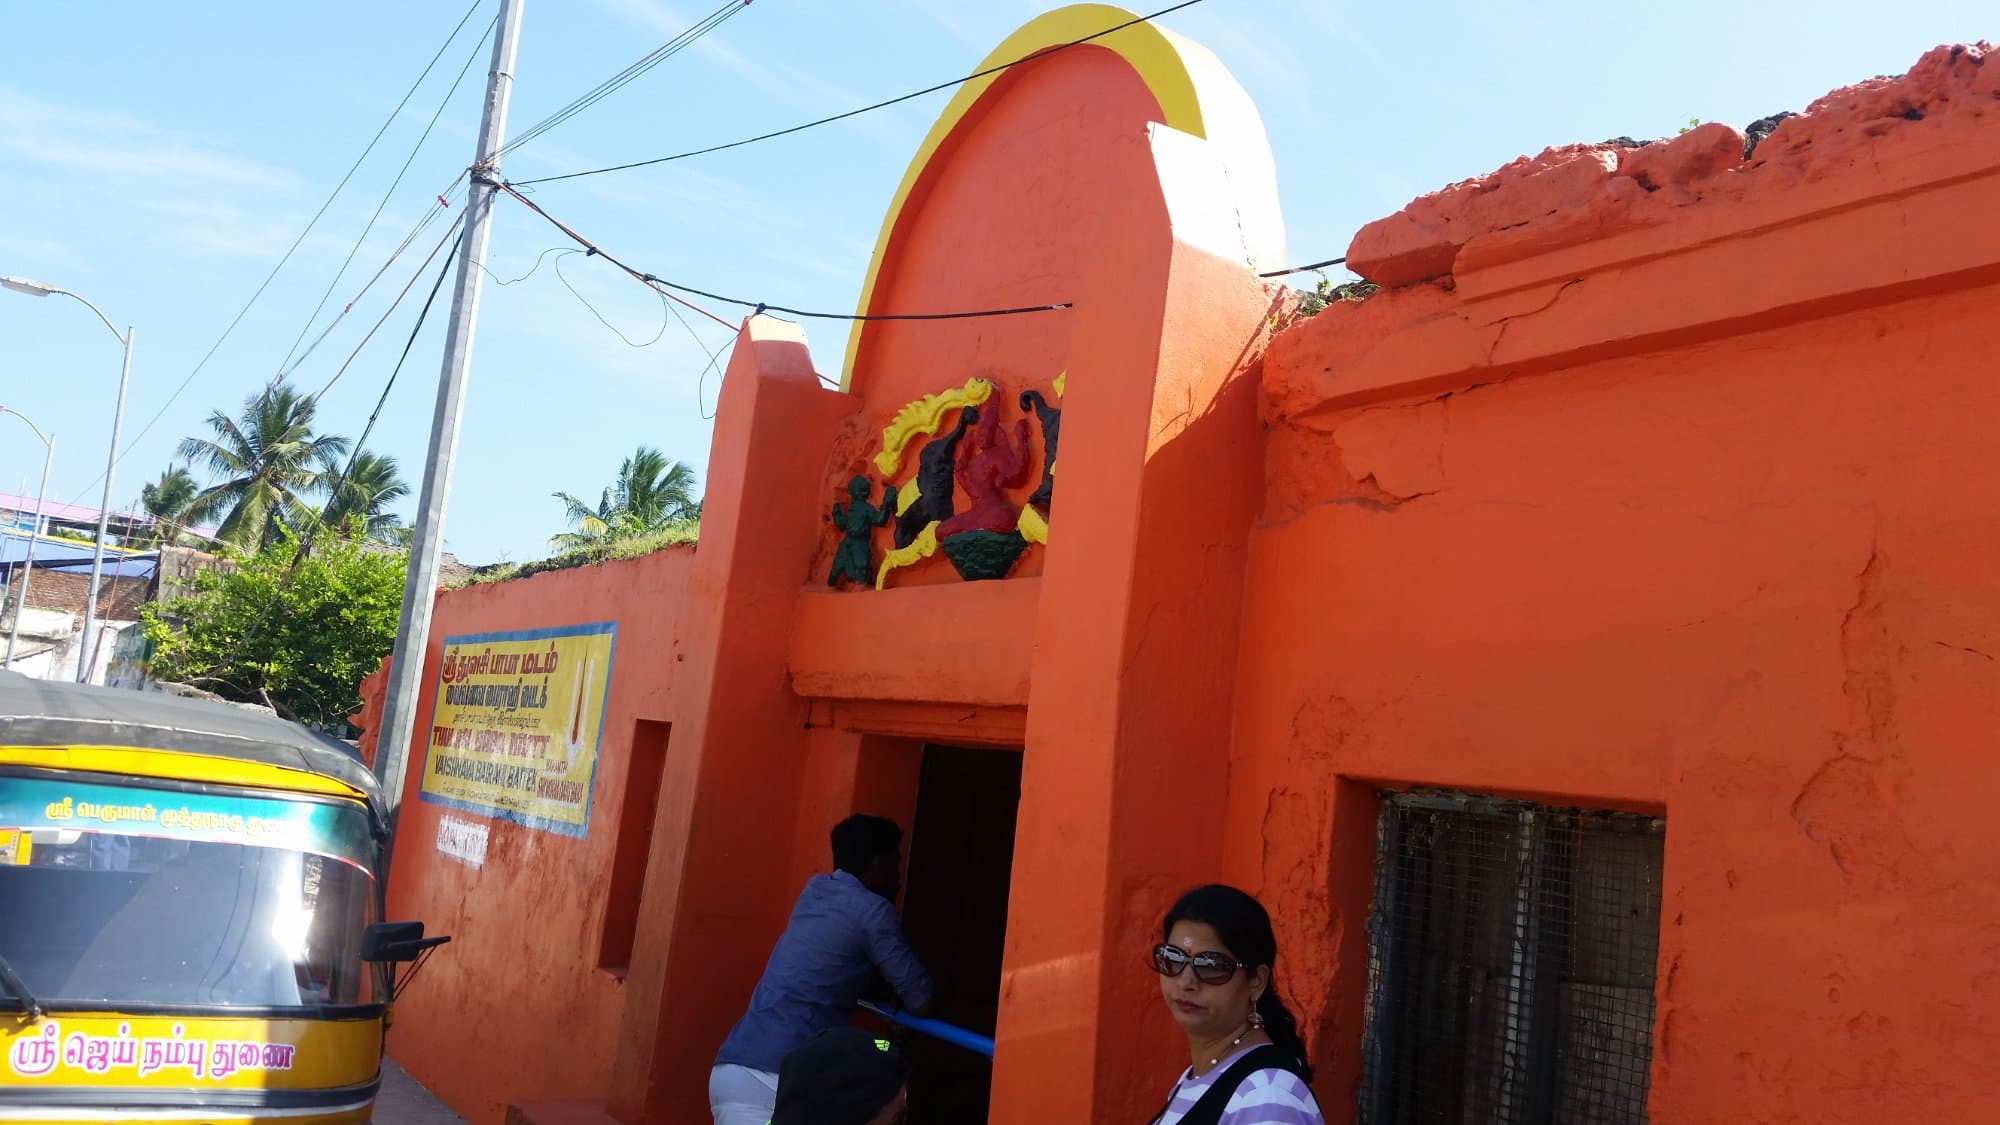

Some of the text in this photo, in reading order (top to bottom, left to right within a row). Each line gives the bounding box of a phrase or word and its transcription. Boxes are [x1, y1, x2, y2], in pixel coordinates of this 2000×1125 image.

[442, 646, 459, 684] ஸ்ரீ
[520, 641, 558, 674] மடம்
[45, 797, 73, 821] ஸ்ரீ
[77, 801, 156, 824] பெருமாள்
[12, 1022, 294, 1077] ஸ்ரீ ஜெய் நம்பு துணை
